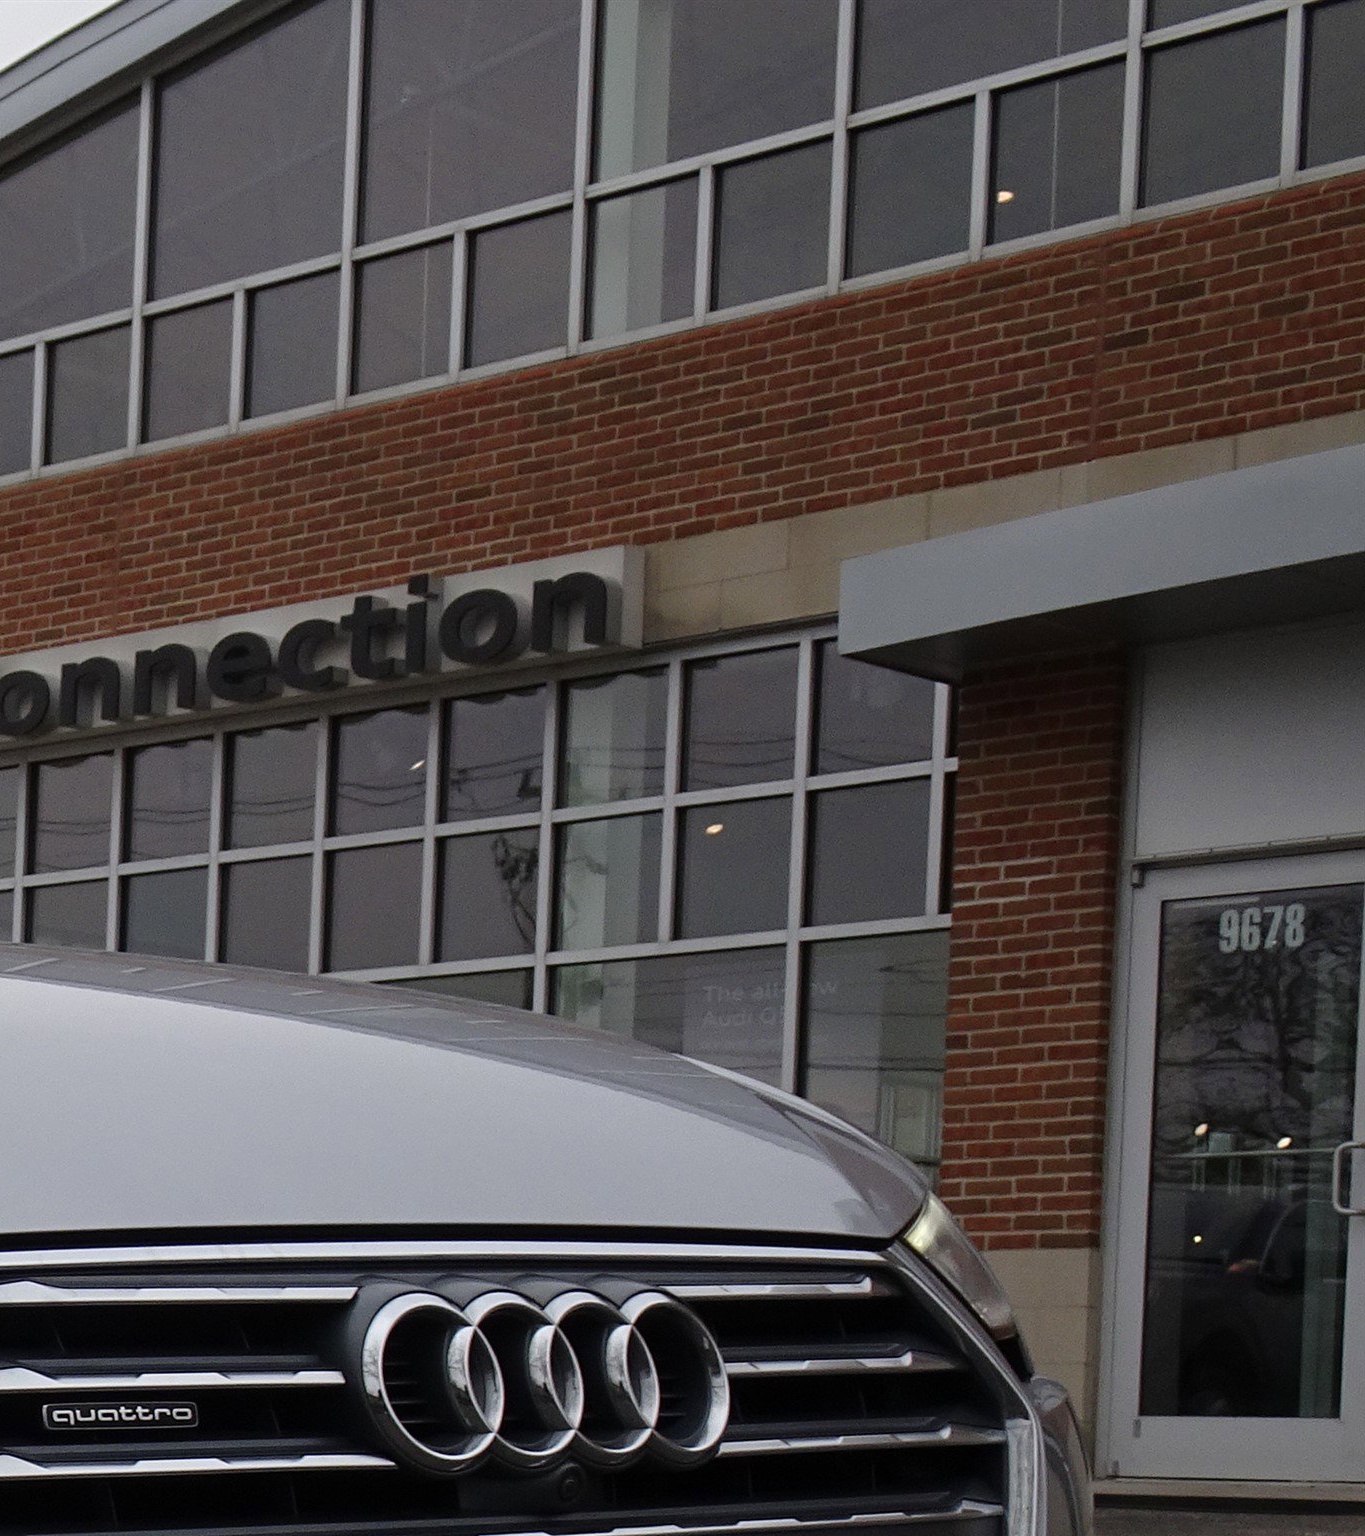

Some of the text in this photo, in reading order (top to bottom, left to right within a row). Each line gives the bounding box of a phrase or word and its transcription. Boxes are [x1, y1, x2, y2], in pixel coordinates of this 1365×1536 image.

[1218, 902, 1305, 954] 9678
[702, 984, 745, 1003] The
[700, 1007, 754, 1030] Audi
[51, 1405, 193, 1426] quattro
